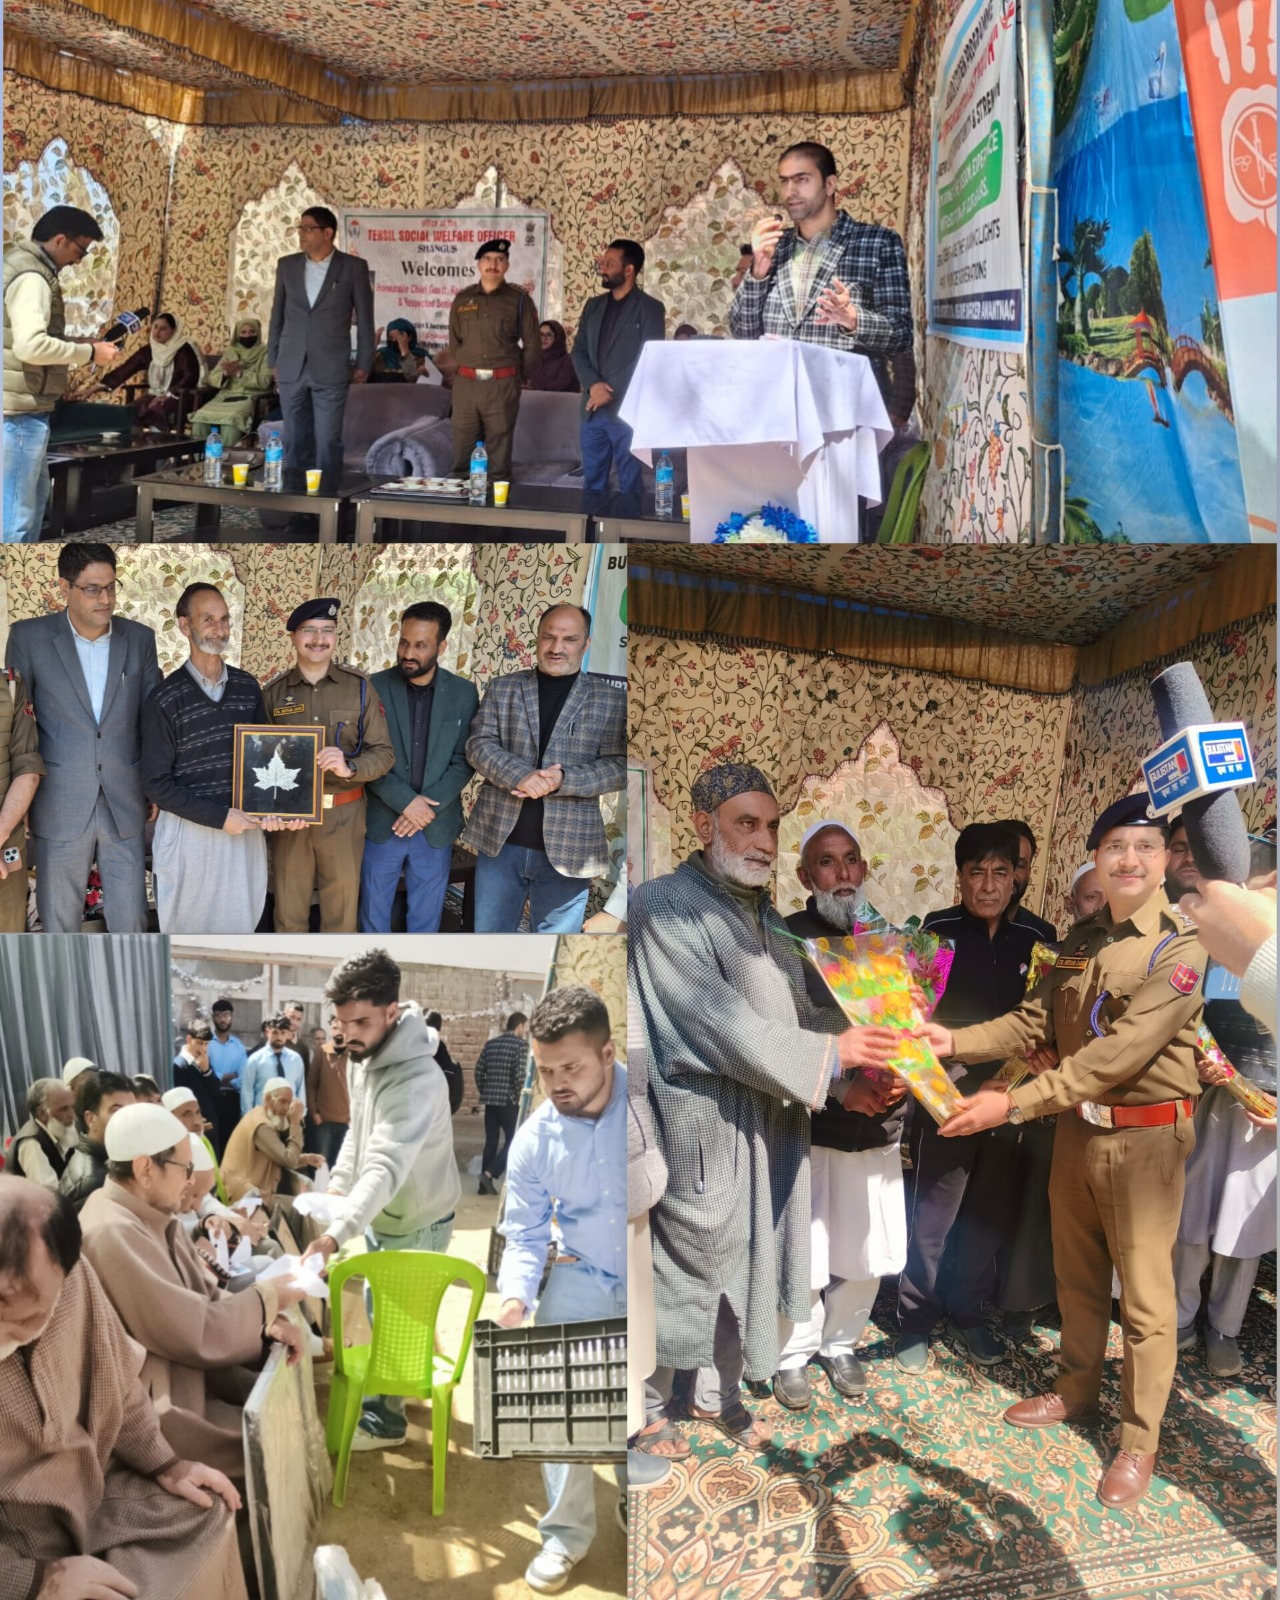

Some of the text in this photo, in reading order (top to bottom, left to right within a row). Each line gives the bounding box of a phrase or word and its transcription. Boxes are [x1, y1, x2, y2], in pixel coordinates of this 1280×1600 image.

[368, 229, 516, 242] TEHSIL SOCIAL WELFARE OFFICER
[979, 217, 1000, 245] LIGHTS
[417, 244, 458, 253] SHANGUS
[401, 260, 476, 277] Welcomes
[410, 284, 427, 295] Chief
[981, 299, 1015, 321] ANANTNAG
